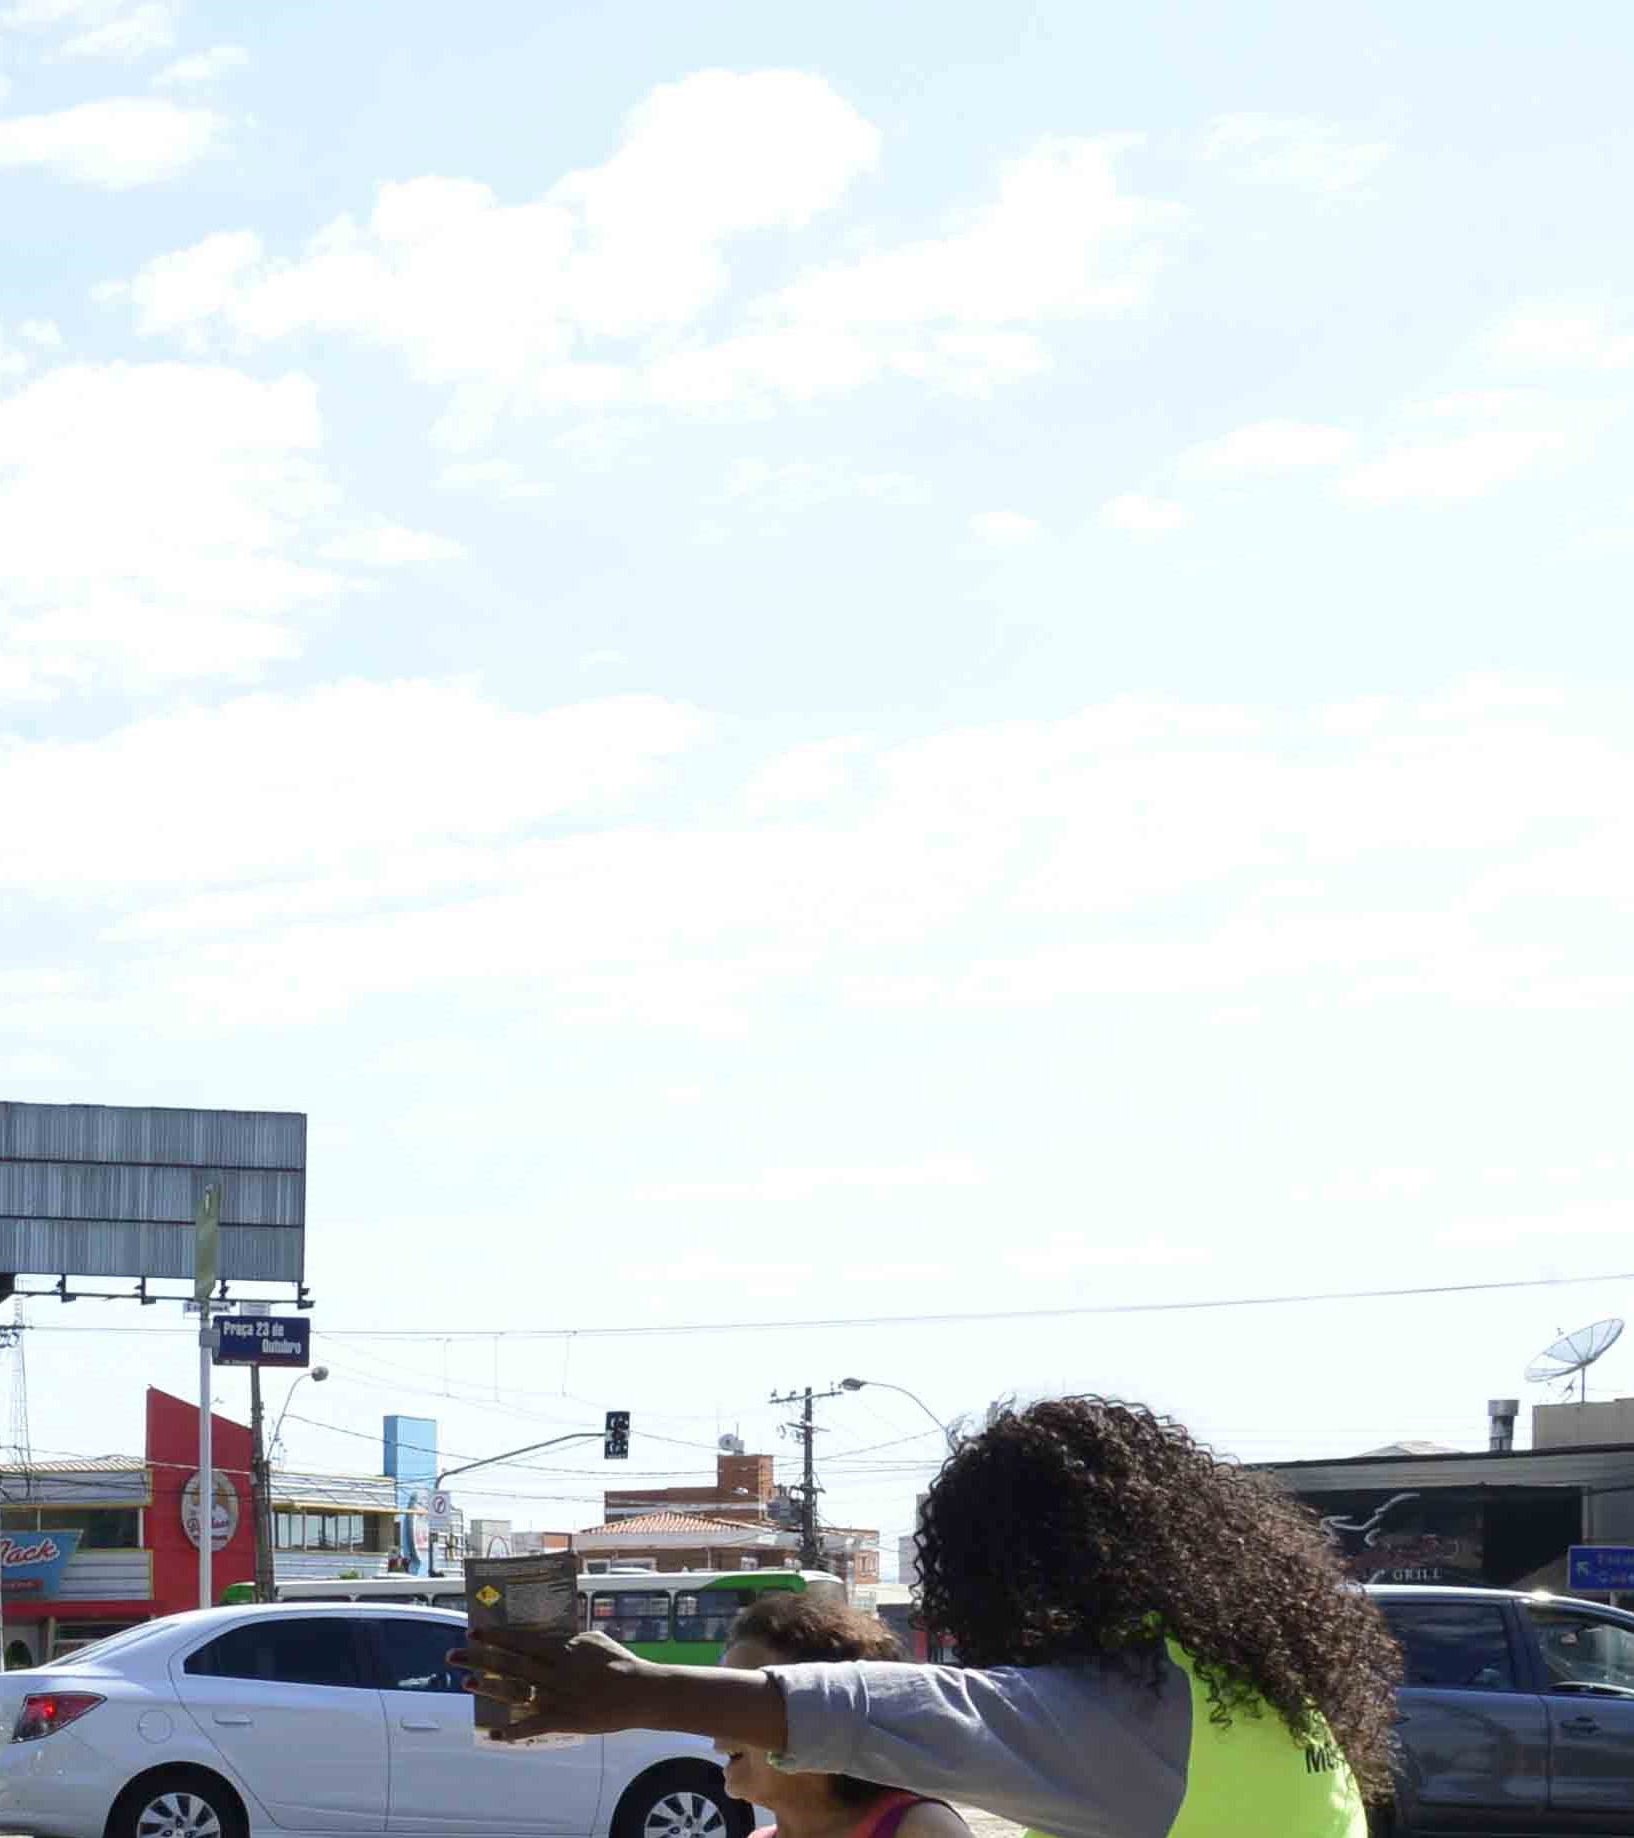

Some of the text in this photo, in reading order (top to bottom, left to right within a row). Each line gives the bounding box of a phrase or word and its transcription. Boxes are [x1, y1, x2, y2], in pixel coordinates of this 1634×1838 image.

[223, 1321, 285, 1339] Praça 23 de
[261, 1338, 302, 1355] Outubro
[1392, 1568, 1444, 1582] GRILL
